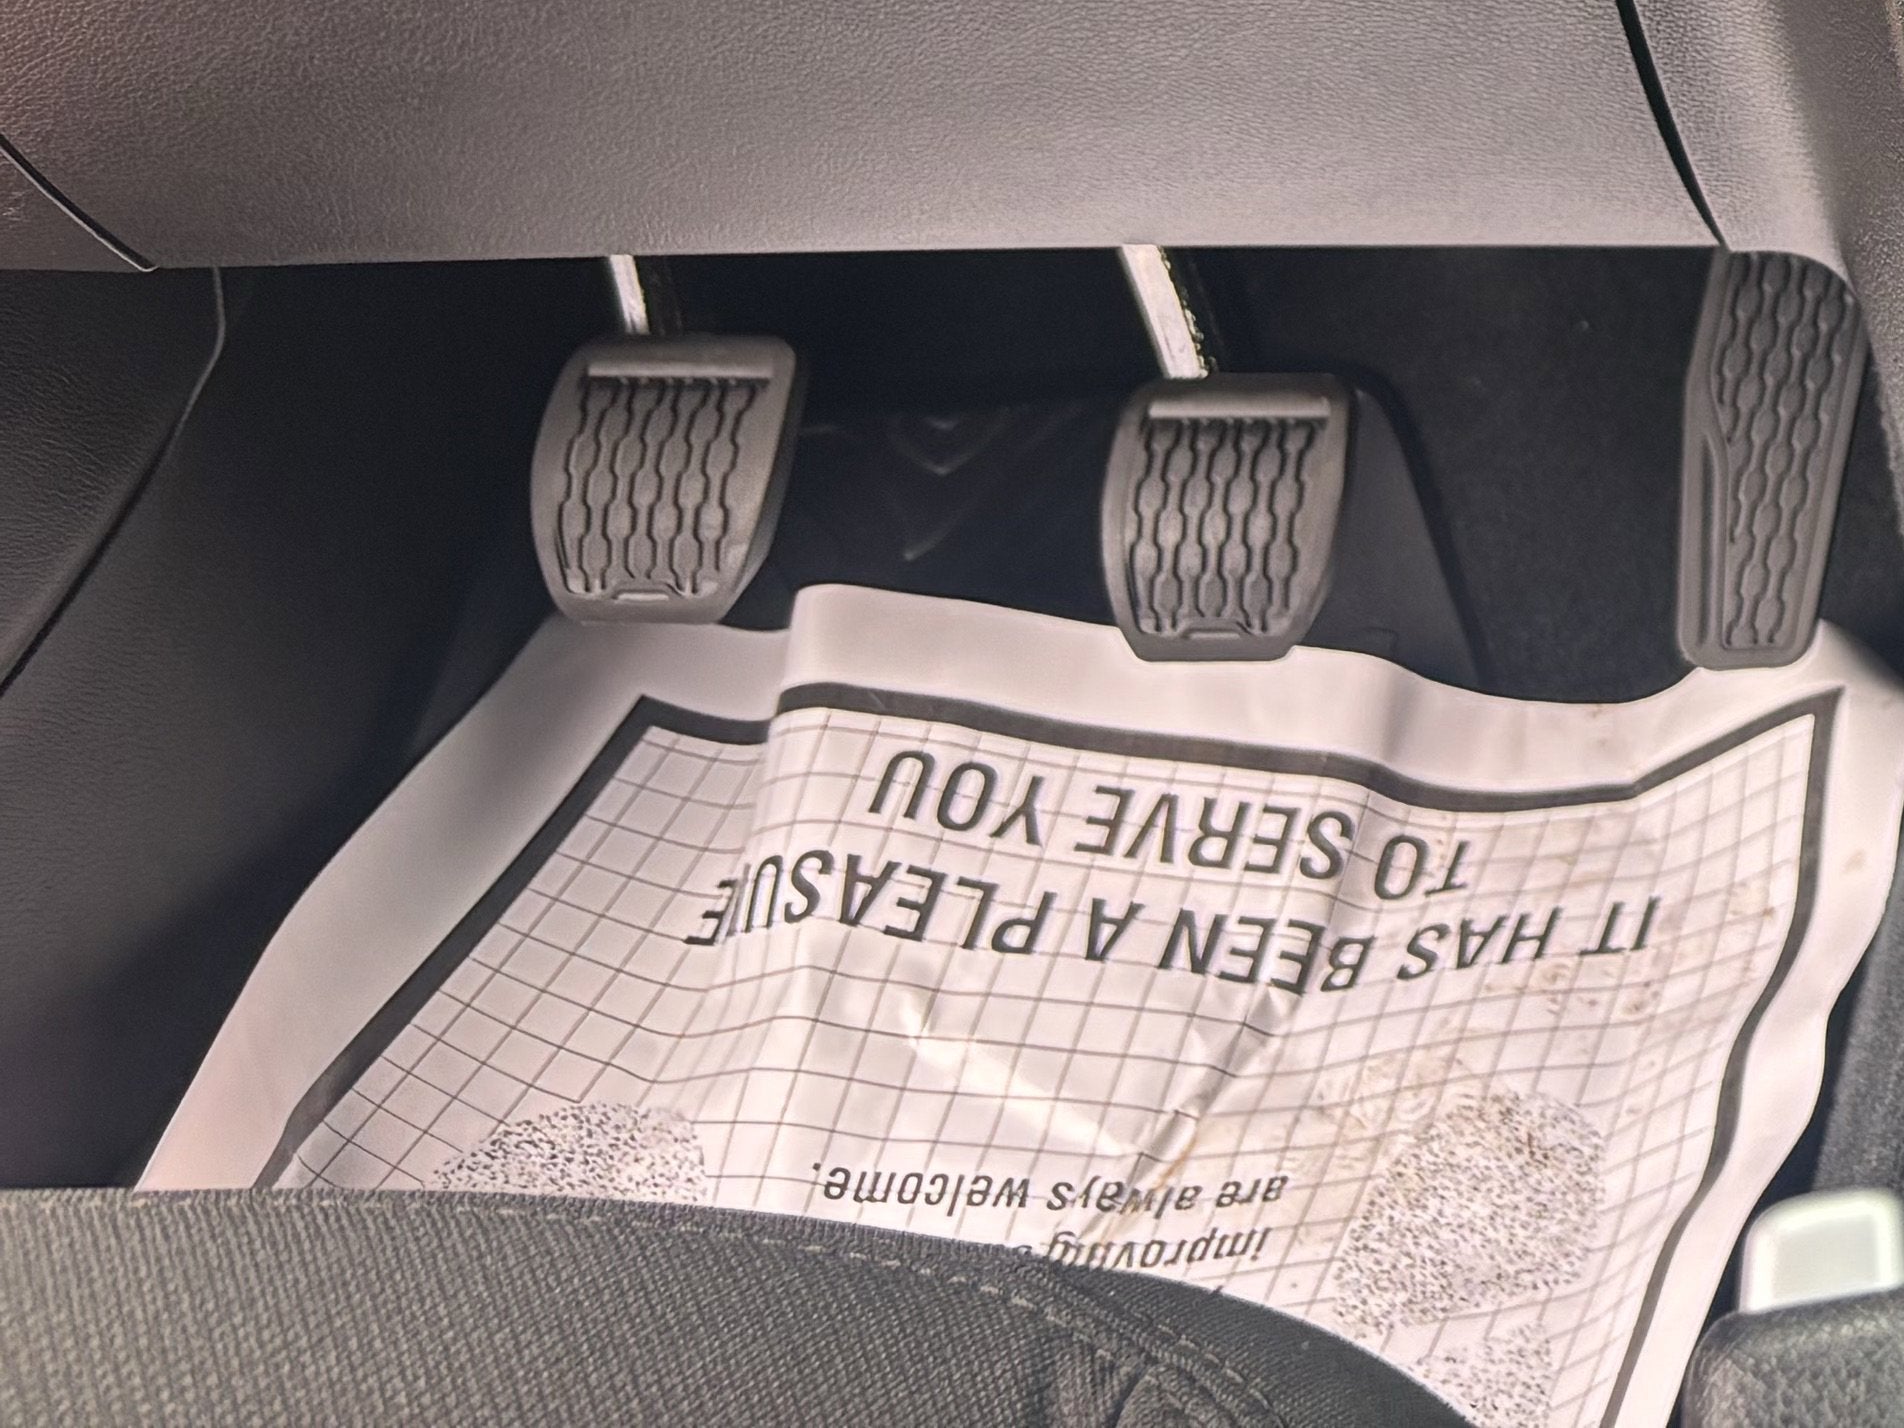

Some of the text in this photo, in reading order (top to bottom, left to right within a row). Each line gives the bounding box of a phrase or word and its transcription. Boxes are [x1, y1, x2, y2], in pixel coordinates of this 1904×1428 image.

[868, 750, 1472, 901] TO SERVE YOU
[1085, 897, 1145, 962] A
[1157, 906, 1375, 994] BEEN
[1397, 904, 1565, 982] HAS
[1580, 894, 1663, 957] IT
[812, 1162, 1289, 1220] are always welcome.
